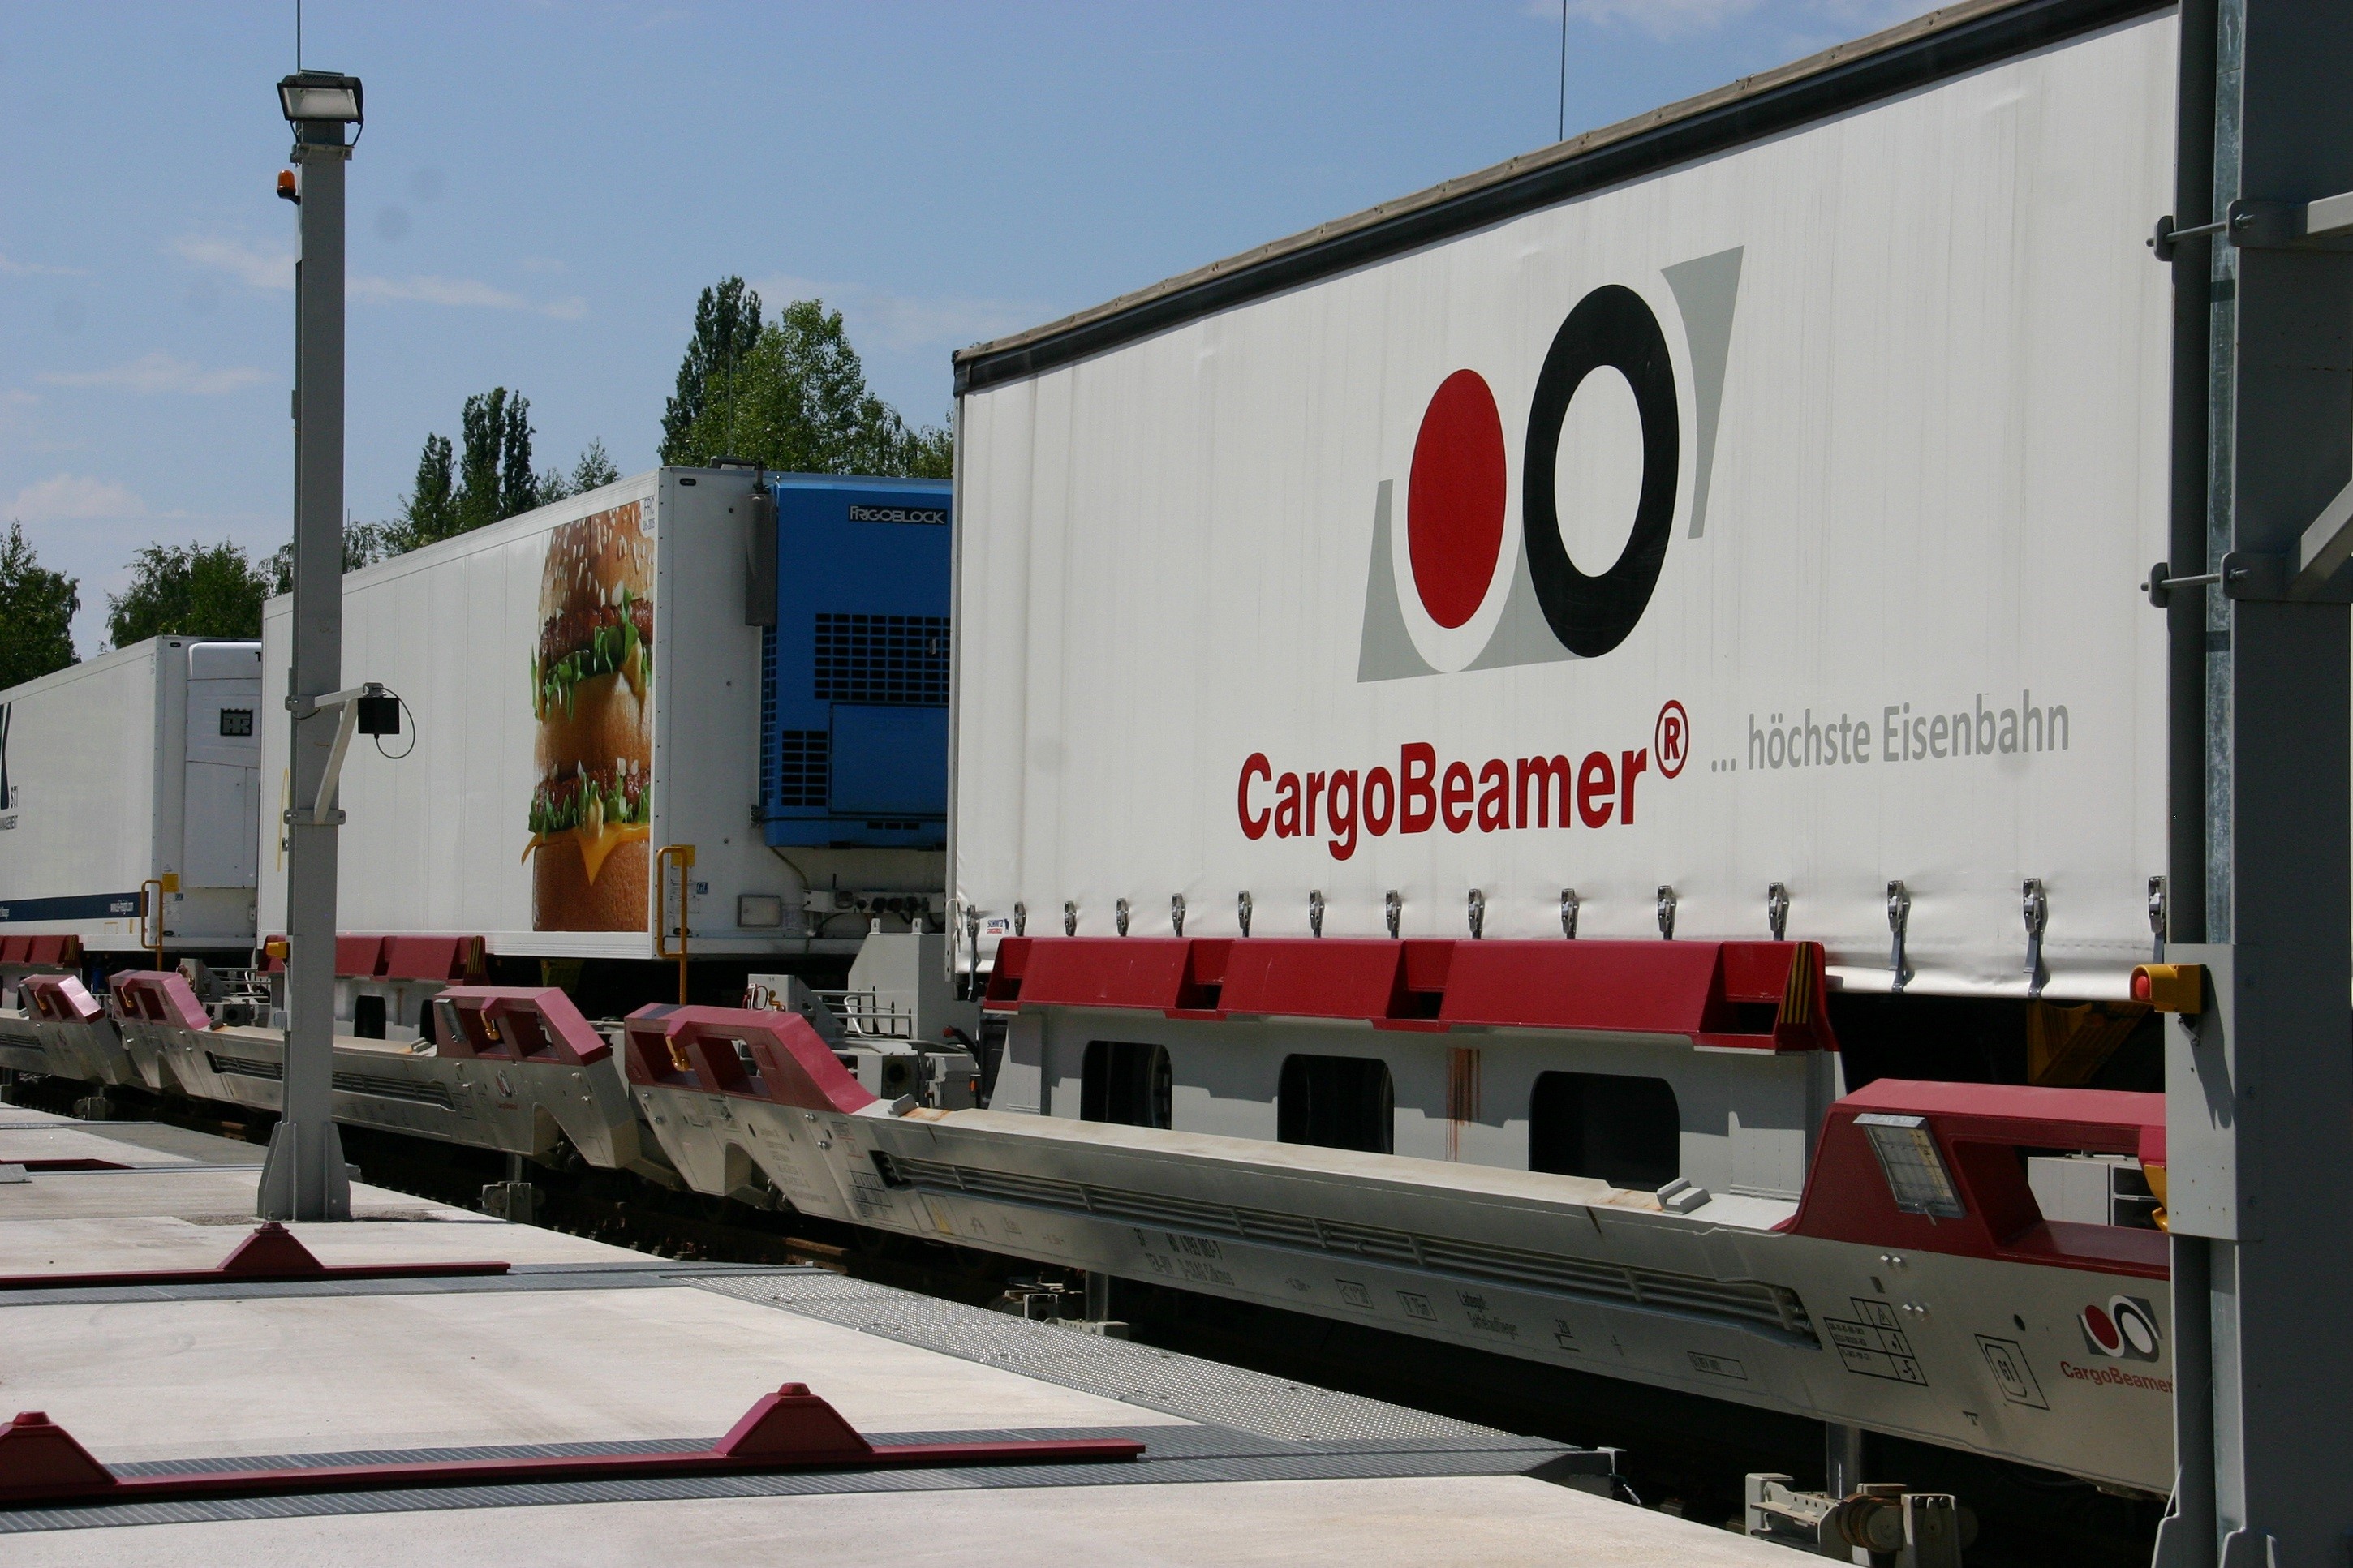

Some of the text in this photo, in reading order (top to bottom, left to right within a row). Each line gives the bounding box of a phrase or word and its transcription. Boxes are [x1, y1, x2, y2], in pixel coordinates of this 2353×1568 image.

[850, 505, 944, 524] FRIGOBLOCK
[1748, 708, 1871, 770] höchste
[1883, 689, 2069, 763] Eisenbahn
